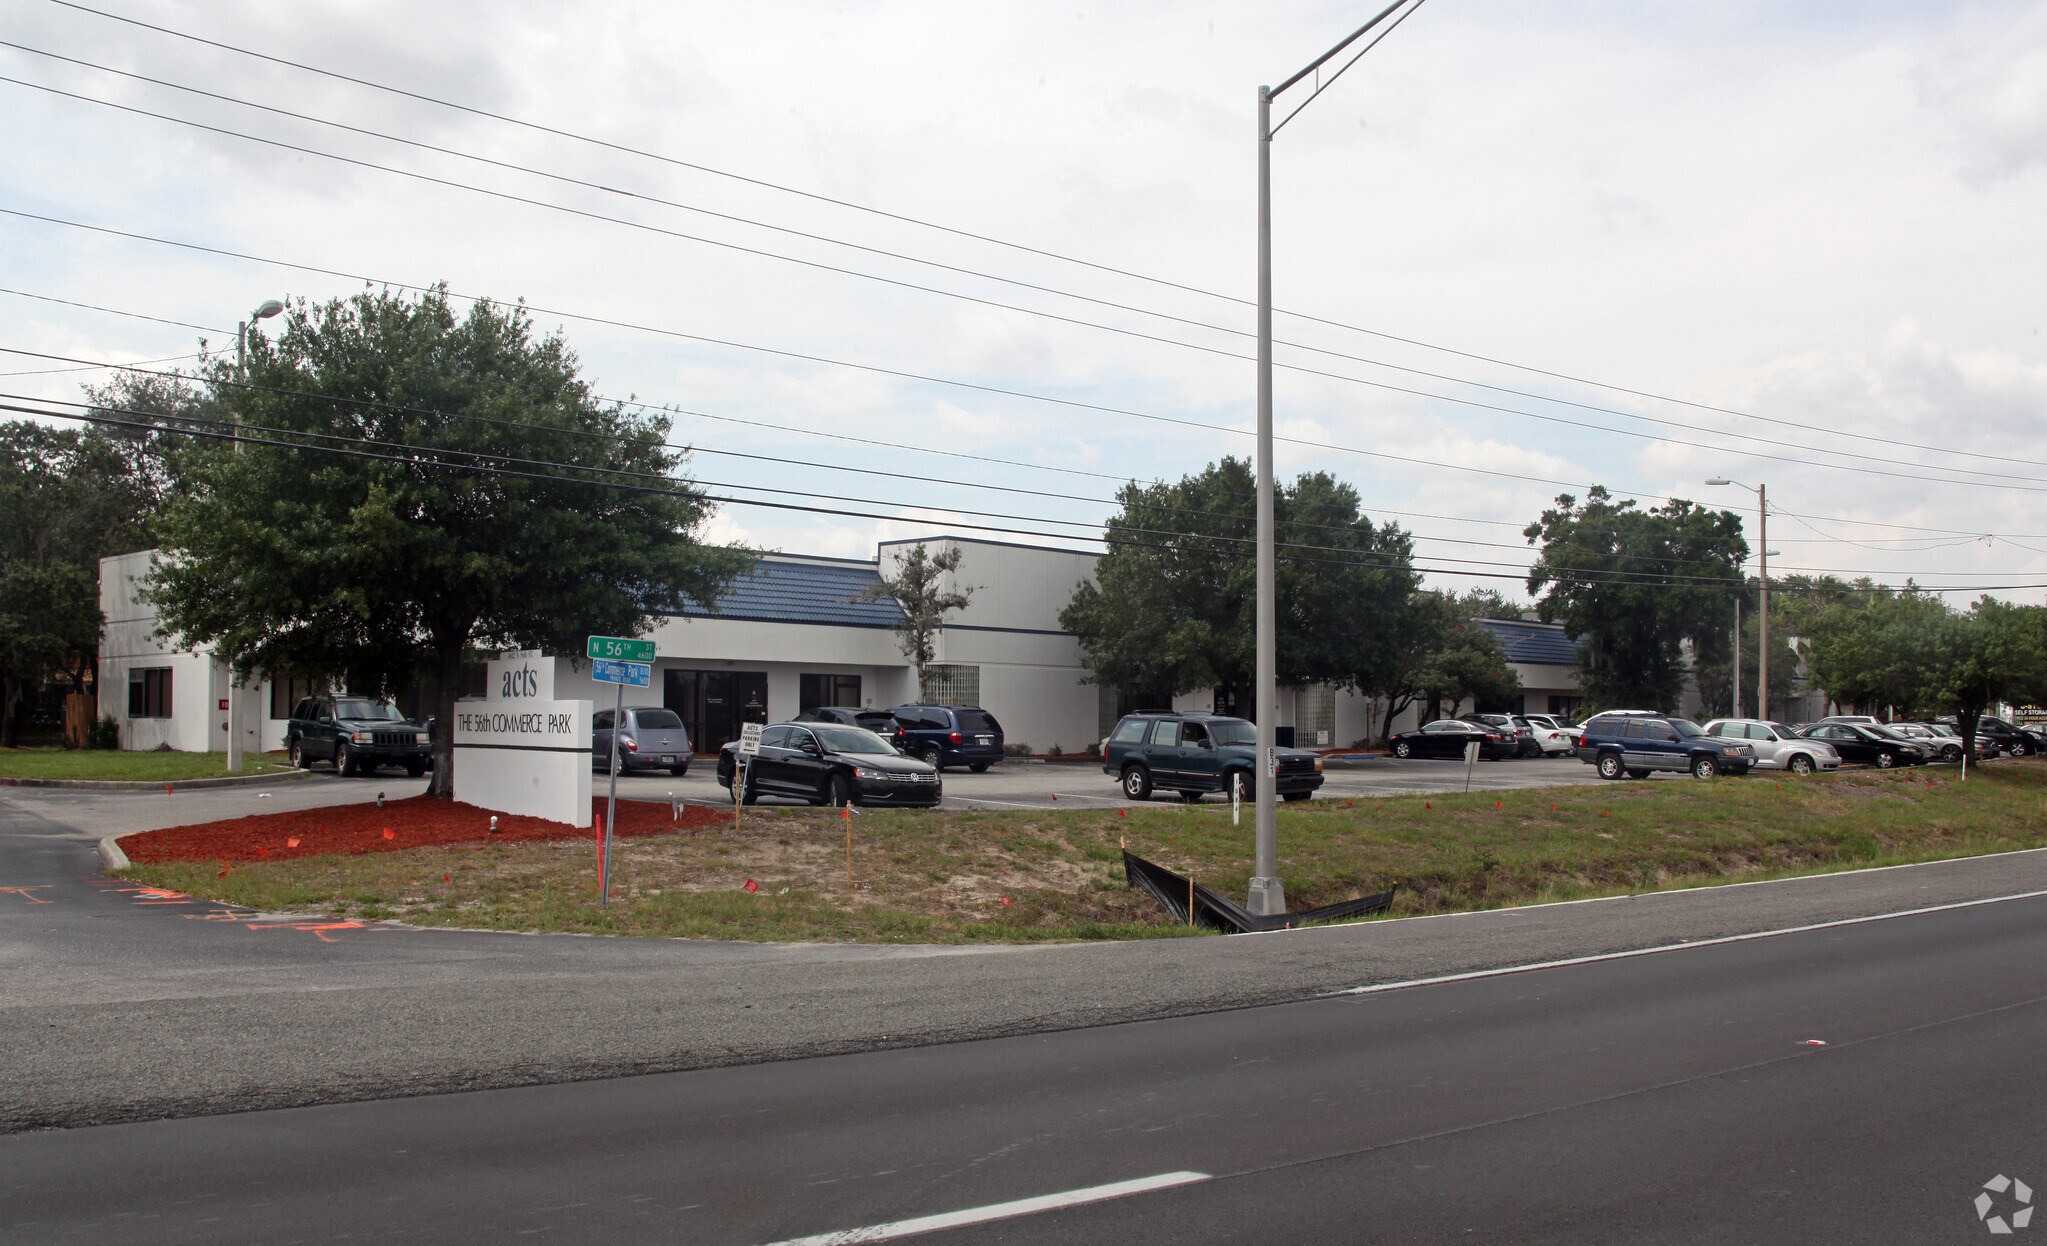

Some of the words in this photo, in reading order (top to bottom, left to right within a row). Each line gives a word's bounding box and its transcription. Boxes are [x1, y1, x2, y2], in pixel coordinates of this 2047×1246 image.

[593, 641, 599, 653] N
[646, 643, 653, 651] ST
[637, 651, 653, 660] 4600
[605, 661, 625, 676] Commerce
[628, 664, 639, 678] Park
[502, 661, 538, 698] acts
[458, 714, 472, 731] THE
[474, 714, 491, 732] 56th
[492, 713, 543, 733] COMMERCE
[548, 713, 572, 734] PARK
